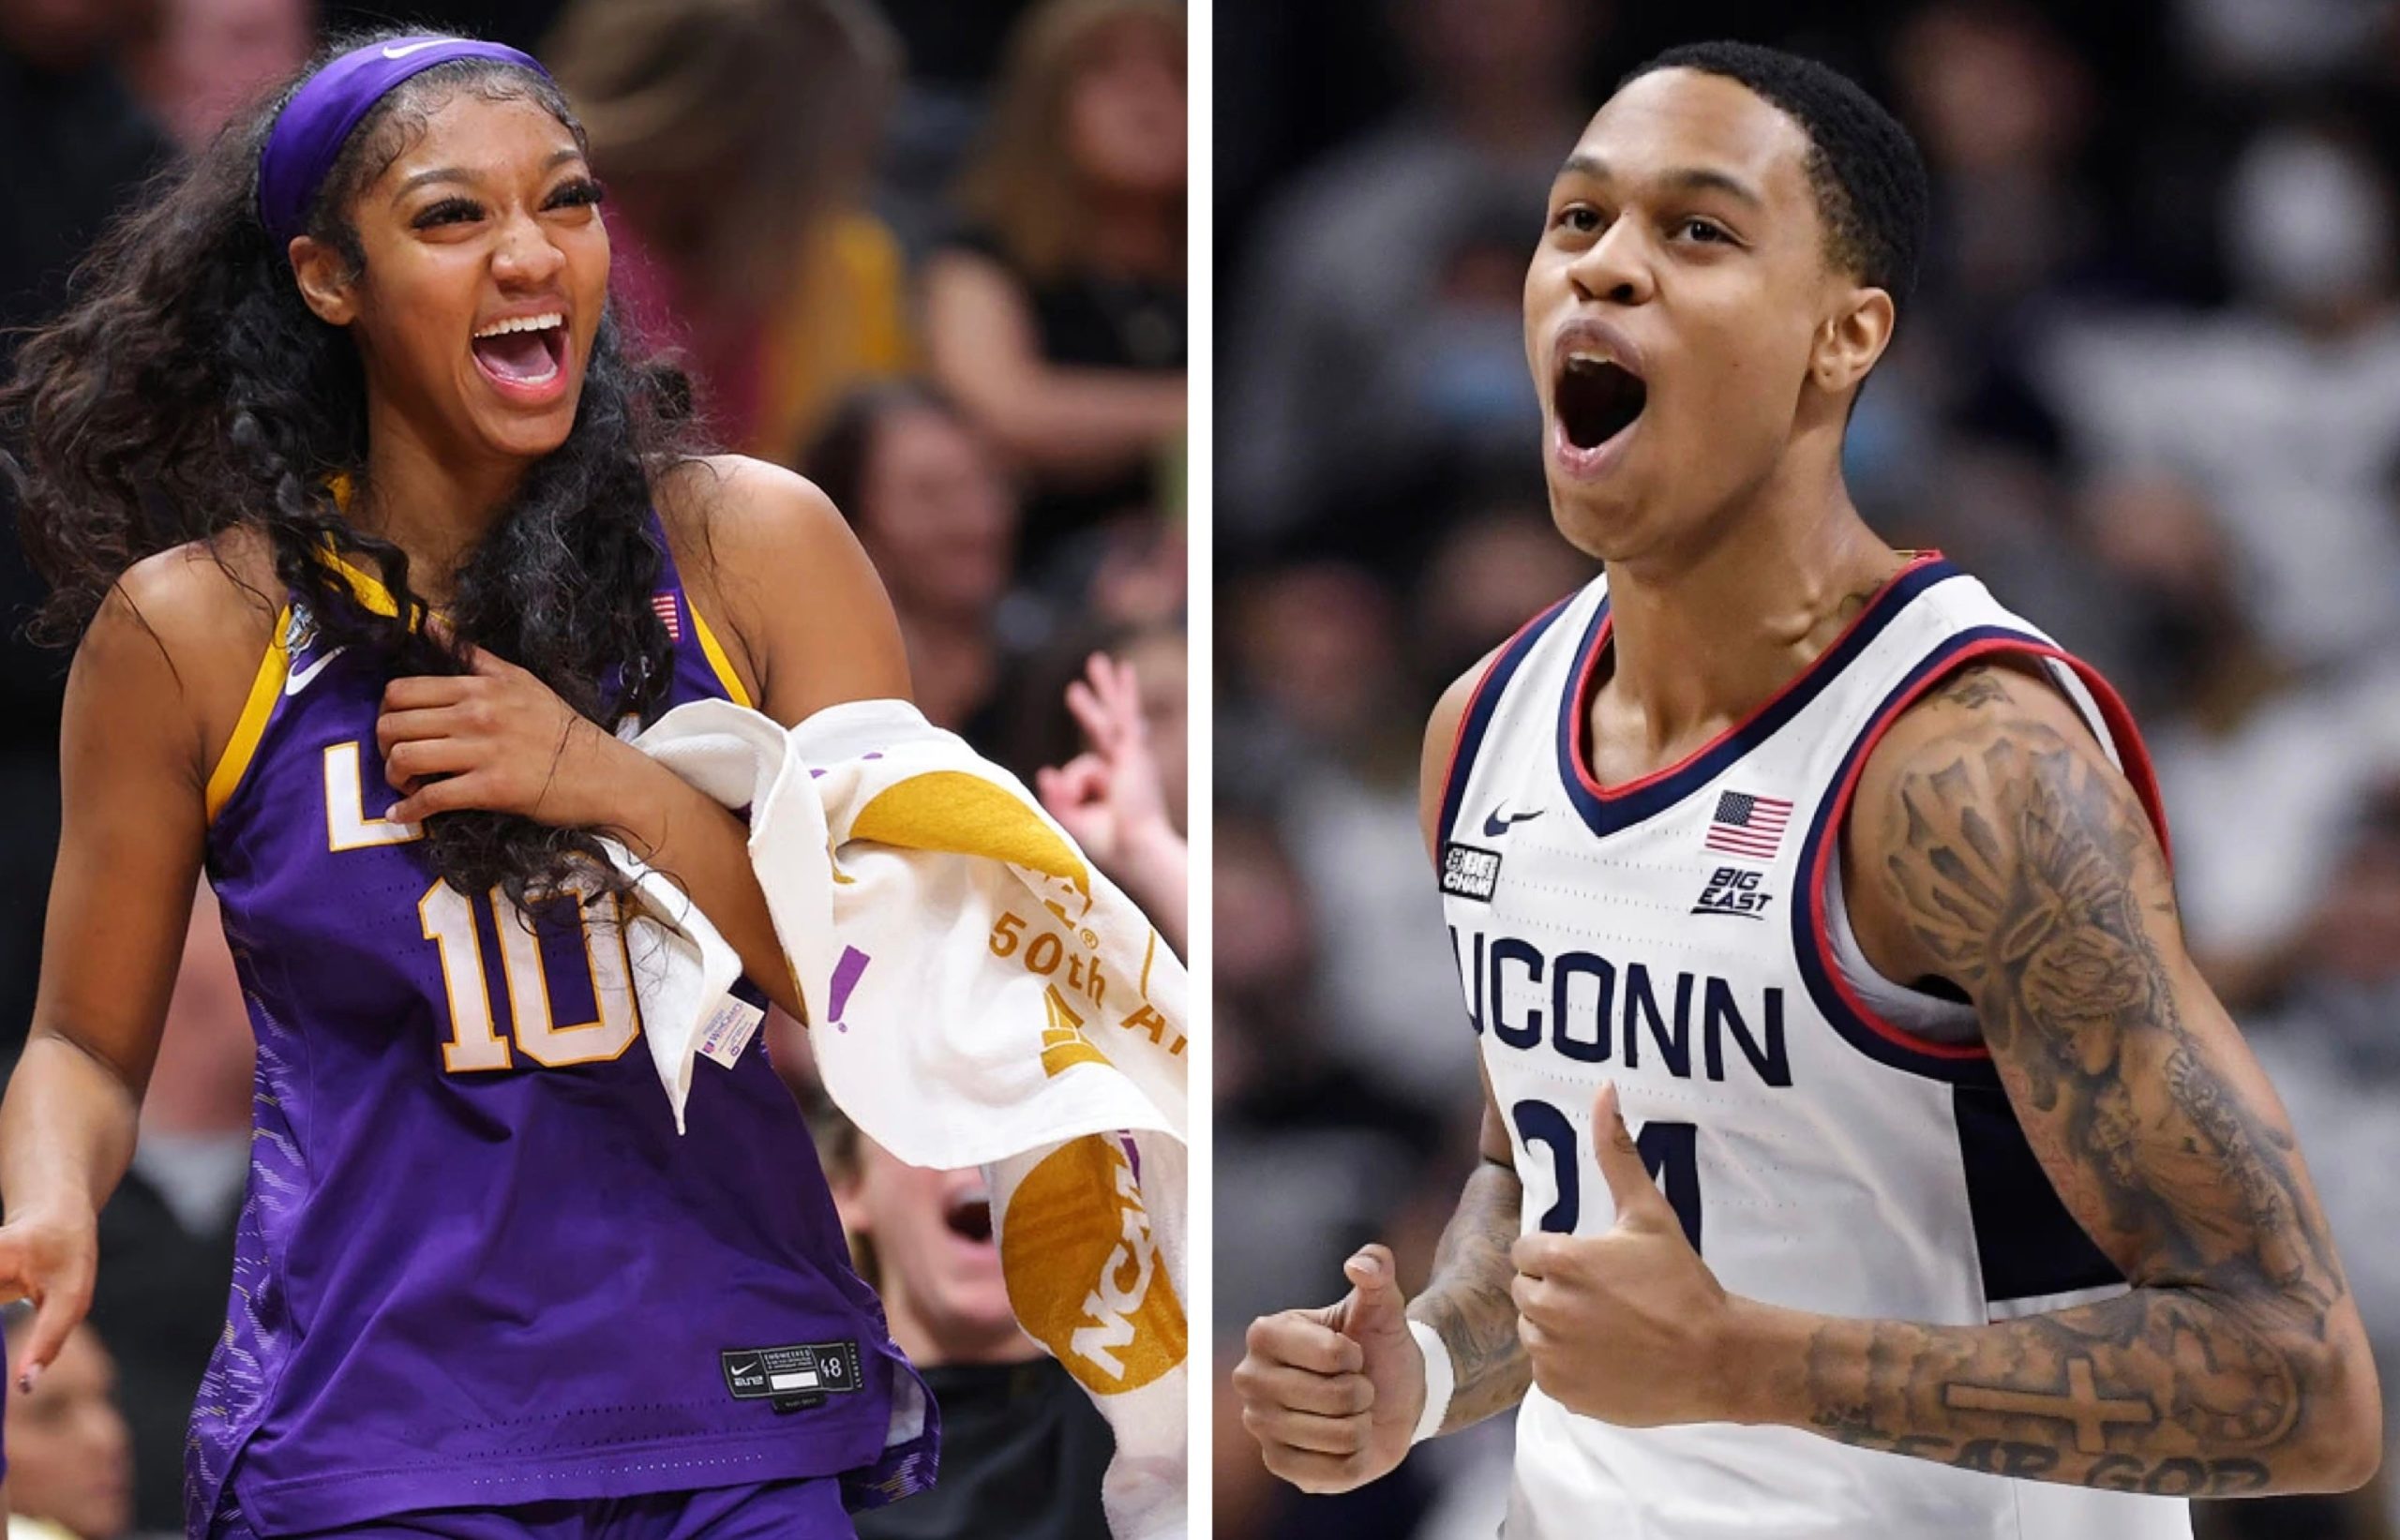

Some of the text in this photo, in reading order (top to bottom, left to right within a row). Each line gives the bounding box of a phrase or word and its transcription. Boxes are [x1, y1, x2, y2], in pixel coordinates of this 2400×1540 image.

[1708, 866, 1763, 890] BIG
[1697, 887, 1774, 911] EAST
[417, 862, 640, 1073] 10
[988, 911, 1106, 1009] 50th
[820, 1356, 843, 1379] 48
